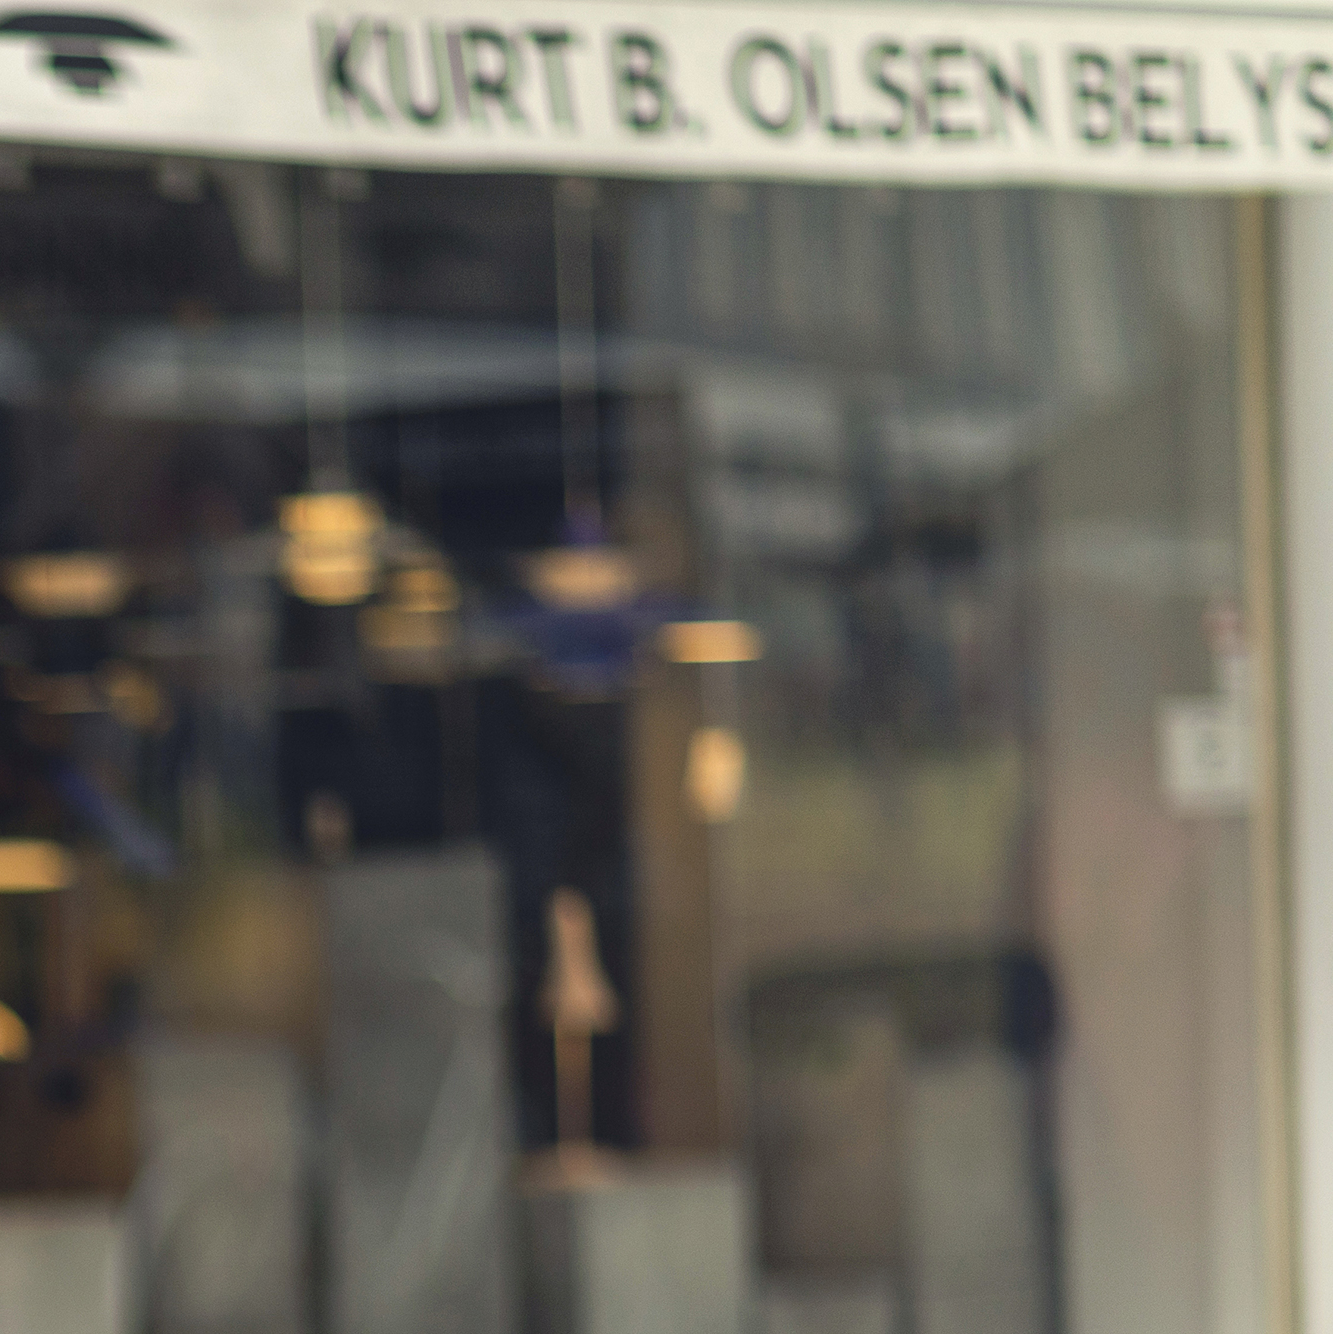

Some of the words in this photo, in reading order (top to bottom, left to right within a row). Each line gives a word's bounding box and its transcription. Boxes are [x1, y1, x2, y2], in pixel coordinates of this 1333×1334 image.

[313, 18, 581, 132] KURT
[611, 31, 707, 139] B.
[725, 33, 1045, 144] OLSEN
